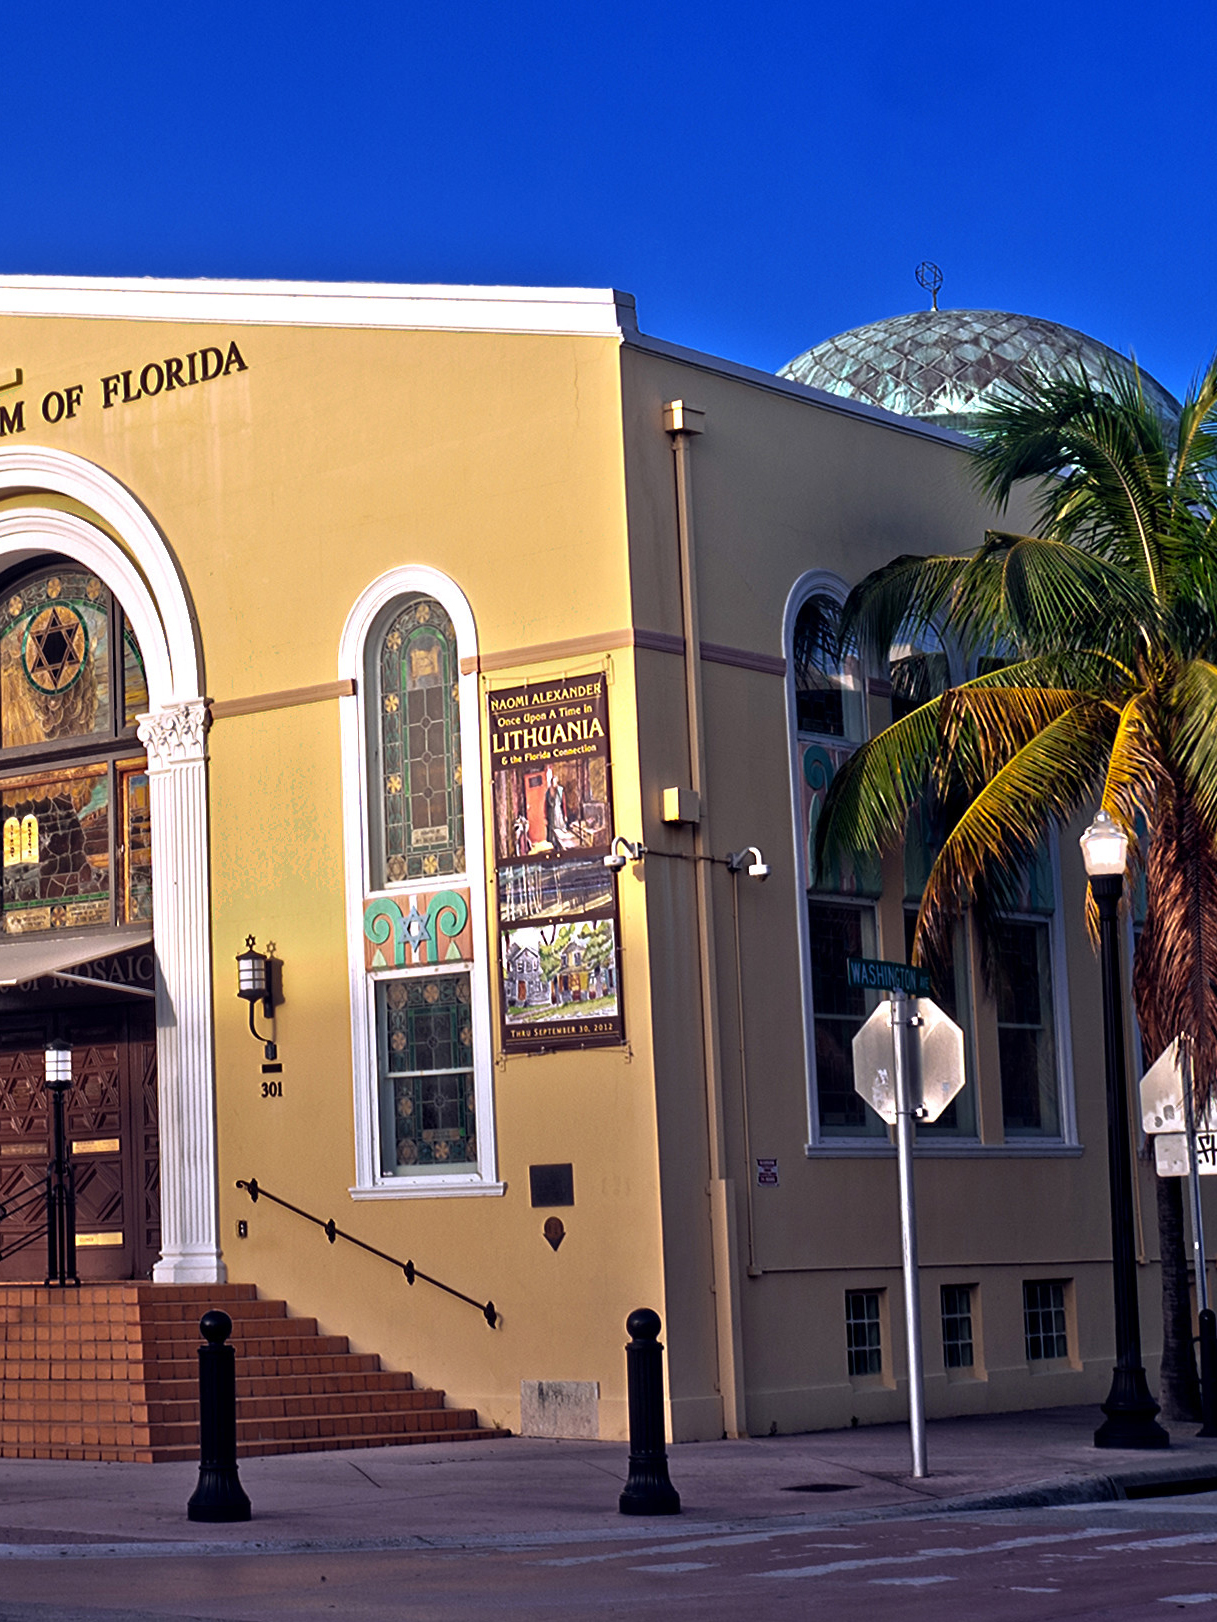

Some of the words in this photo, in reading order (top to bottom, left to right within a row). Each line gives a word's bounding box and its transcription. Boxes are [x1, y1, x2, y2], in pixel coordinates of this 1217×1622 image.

[41, 385, 83, 425] OF
[100, 340, 249, 409] FLORIDA
[491, 695, 529, 711] NAOMI
[532, 682, 602, 705] ALEXANDER
[497, 716, 521, 727] Once
[523, 713, 547, 724] Upon
[549, 709, 557, 719] A
[558, 706, 581, 717] Time
[492, 717, 605, 754] LITHUANIA
[524, 750, 551, 761] Florida
[552, 744, 597, 757] Connection
[850, 961, 917, 990] WASHINGTON
[919, 976, 930, 990] AVE
[510, 1029, 531, 1038] THRU
[533, 1025, 576, 1037] SEPTEMBER
[594, 1022, 613, 1032] 2012
[261, 1081, 283, 1098] 301
